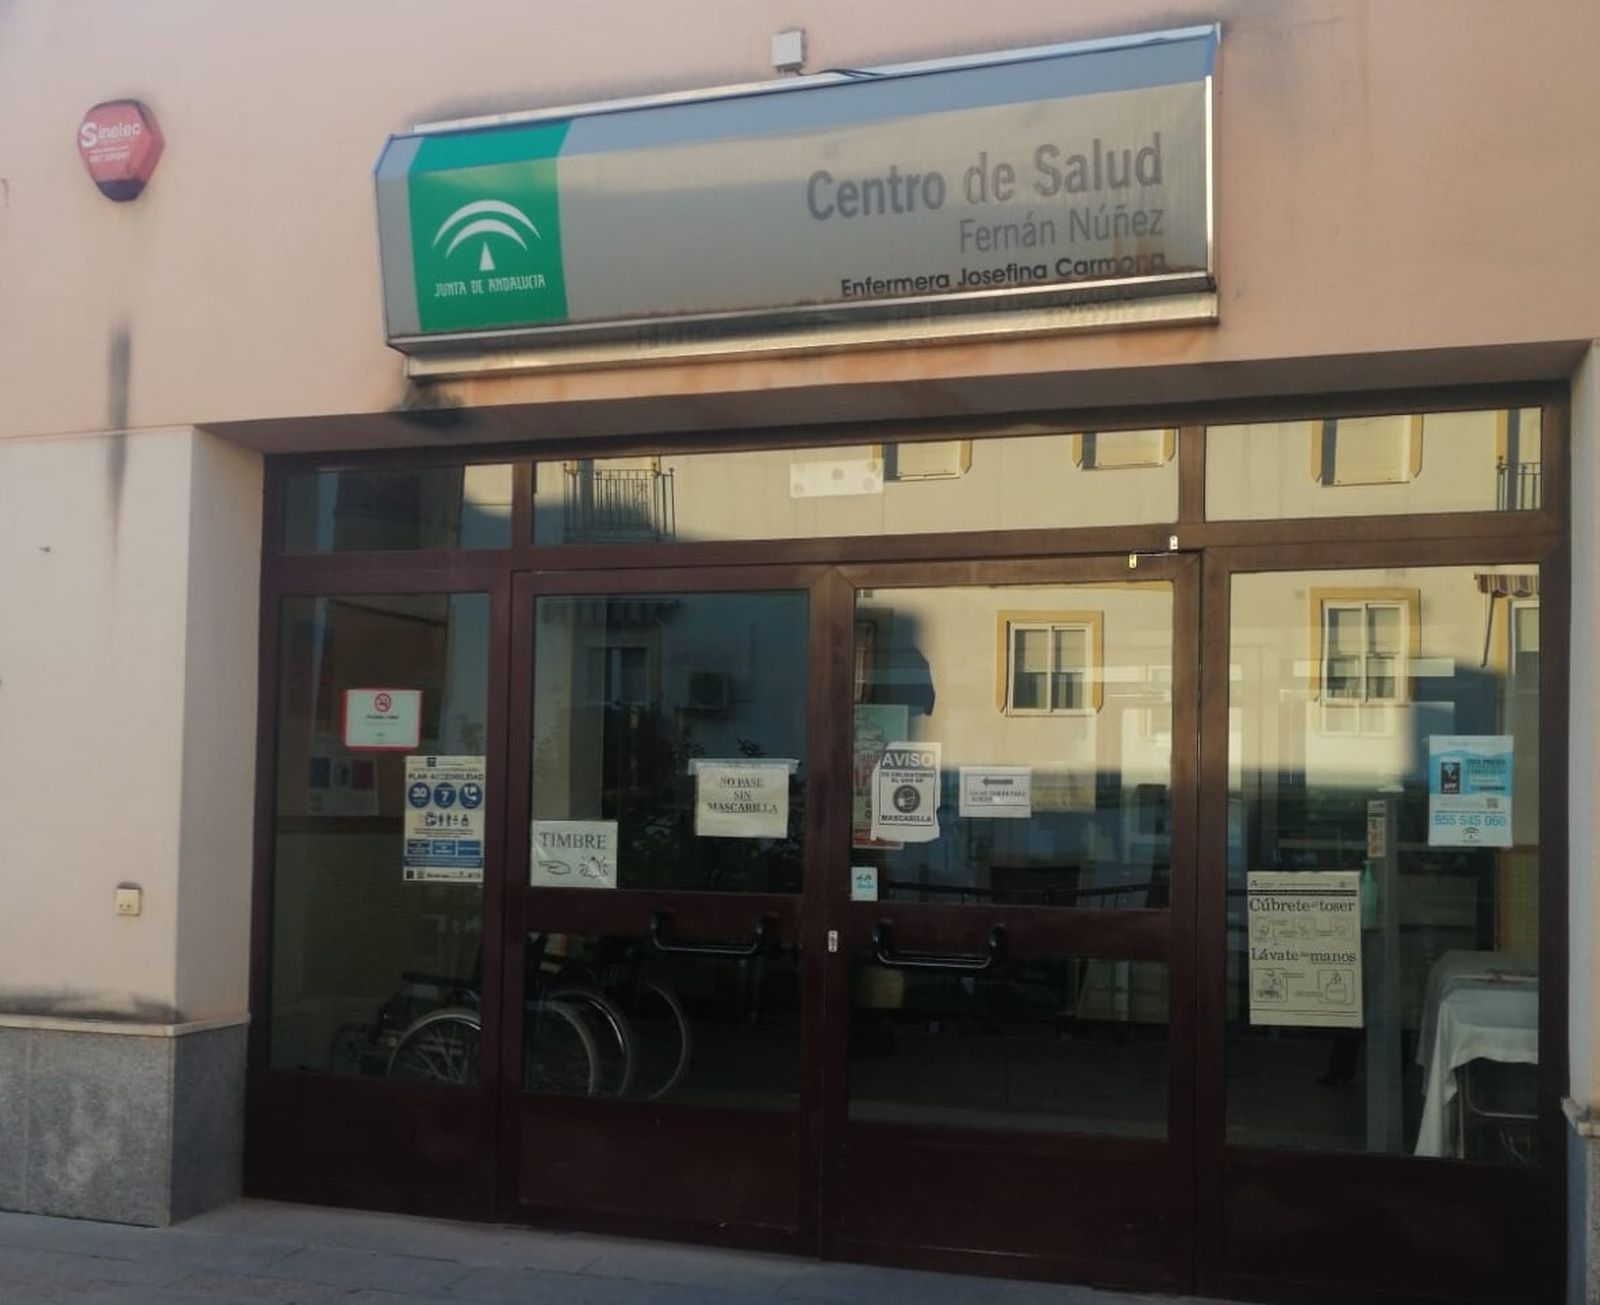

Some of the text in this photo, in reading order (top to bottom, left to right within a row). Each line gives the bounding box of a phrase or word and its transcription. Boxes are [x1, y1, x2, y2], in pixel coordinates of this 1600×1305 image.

[81, 122, 141, 148] Sinelec
[807, 131, 1162, 221] Centro de Salud
[959, 204, 1164, 253] Fernán Núñez
[841, 252, 1166, 298] Enfermera Josefina Carmona
[434, 281, 467, 297] JUNTA
[471, 279, 484, 294] DE
[881, 752, 934, 768] AVISO
[719, 777, 736, 788] NO
[412, 786, 428, 798] 30
[441, 790, 450, 803] 7
[733, 789, 752, 801] SIN
[707, 801, 778, 814] MASCARILLA
[881, 814, 932, 822] MASCARILLA
[1434, 814, 1507, 828] 955 545 060
[539, 832, 607, 850] TIMBRE
[1248, 897, 1311, 913] Cúbrete
[1319, 900, 1355, 913] toser
[1251, 947, 1299, 962] Lávate
[1310, 951, 1357, 963] manos
